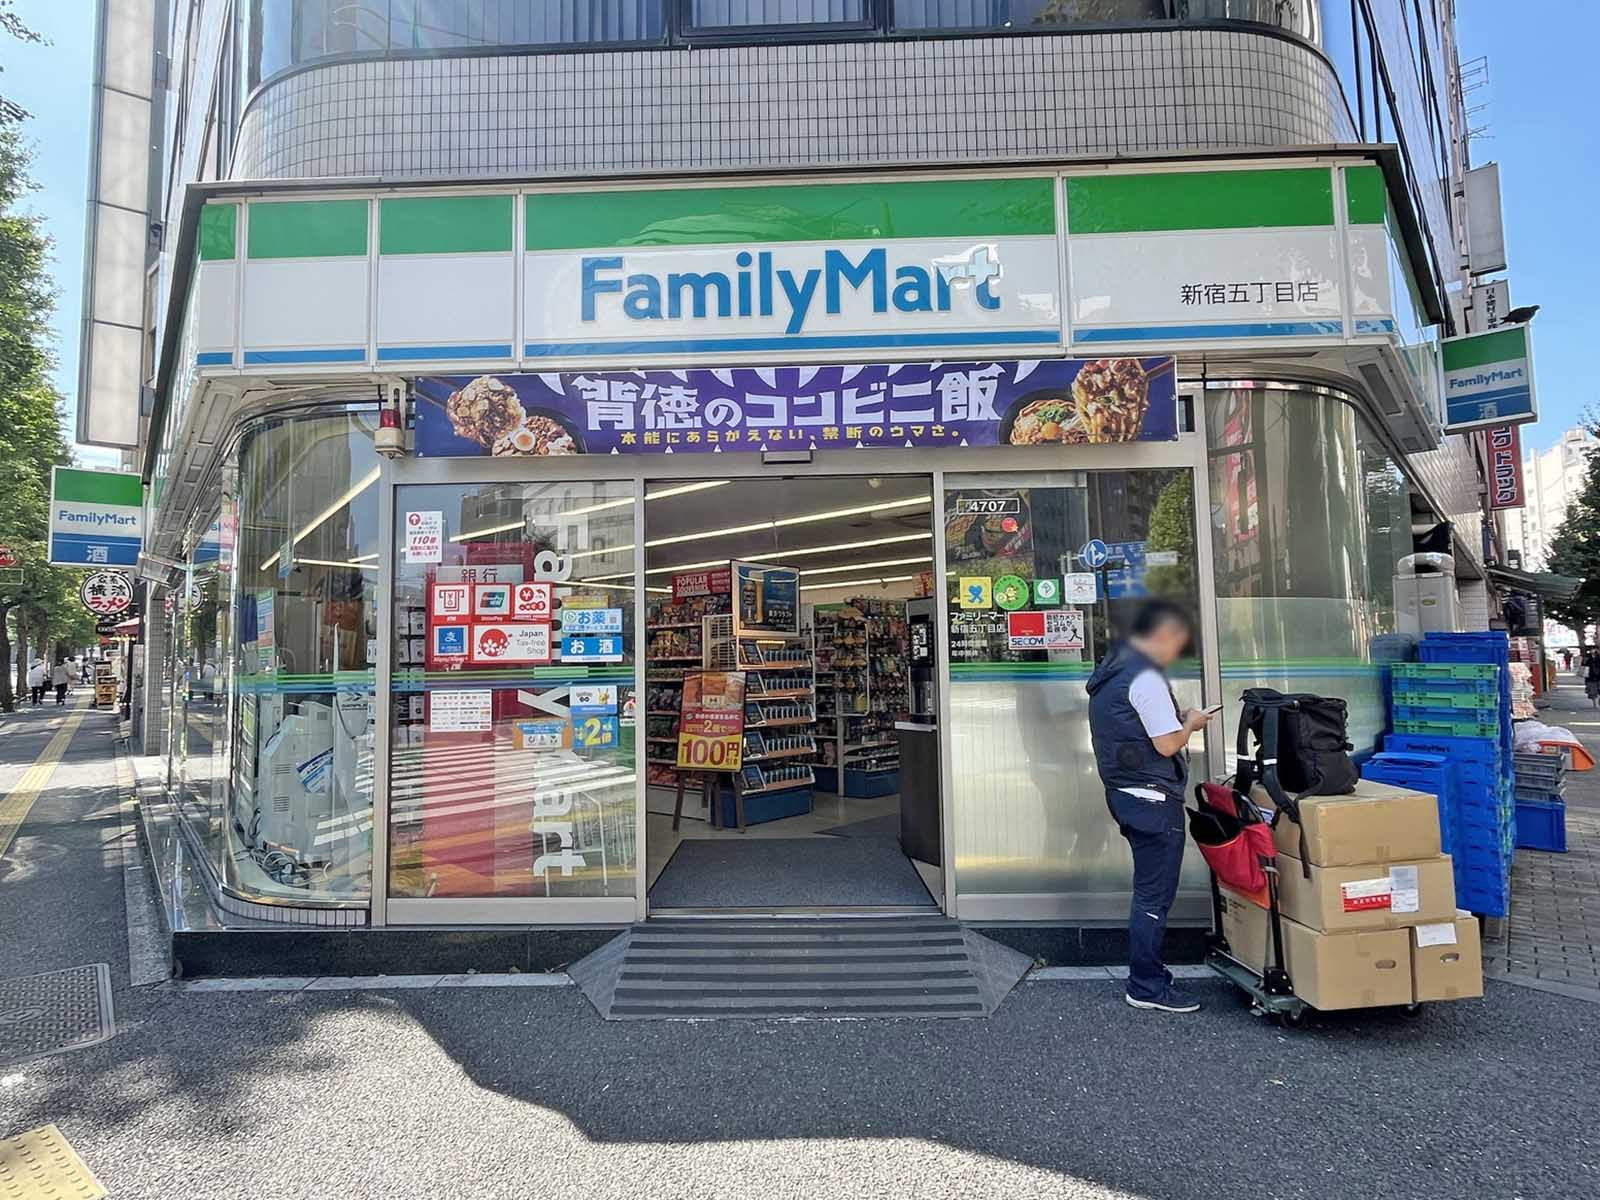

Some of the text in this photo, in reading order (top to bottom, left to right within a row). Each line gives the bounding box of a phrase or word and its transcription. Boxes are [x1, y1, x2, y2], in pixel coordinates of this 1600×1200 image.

[582, 247, 1002, 335] FamilyMart
[1181, 280, 1319, 305] 新宿五丁目店
[1449, 367, 1524, 389] FamilyMart
[573, 366, 1003, 431] 背徳のコンビニ飯
[1478, 402, 1499, 420] 酒
[620, 424, 961, 445] 本能にあらがえない、禁断のウマさ。
[969, 501, 1007, 512] 4707
[58, 510, 137, 527] FamilyMart
[86, 546, 109, 563] 酒
[90, 596, 130, 612] ラーメン
[519, 629, 544, 638] Japan
[1011, 637, 1045, 646] SECOM
[527, 647, 546, 657] Shop
[570, 639, 613, 654] お酒
